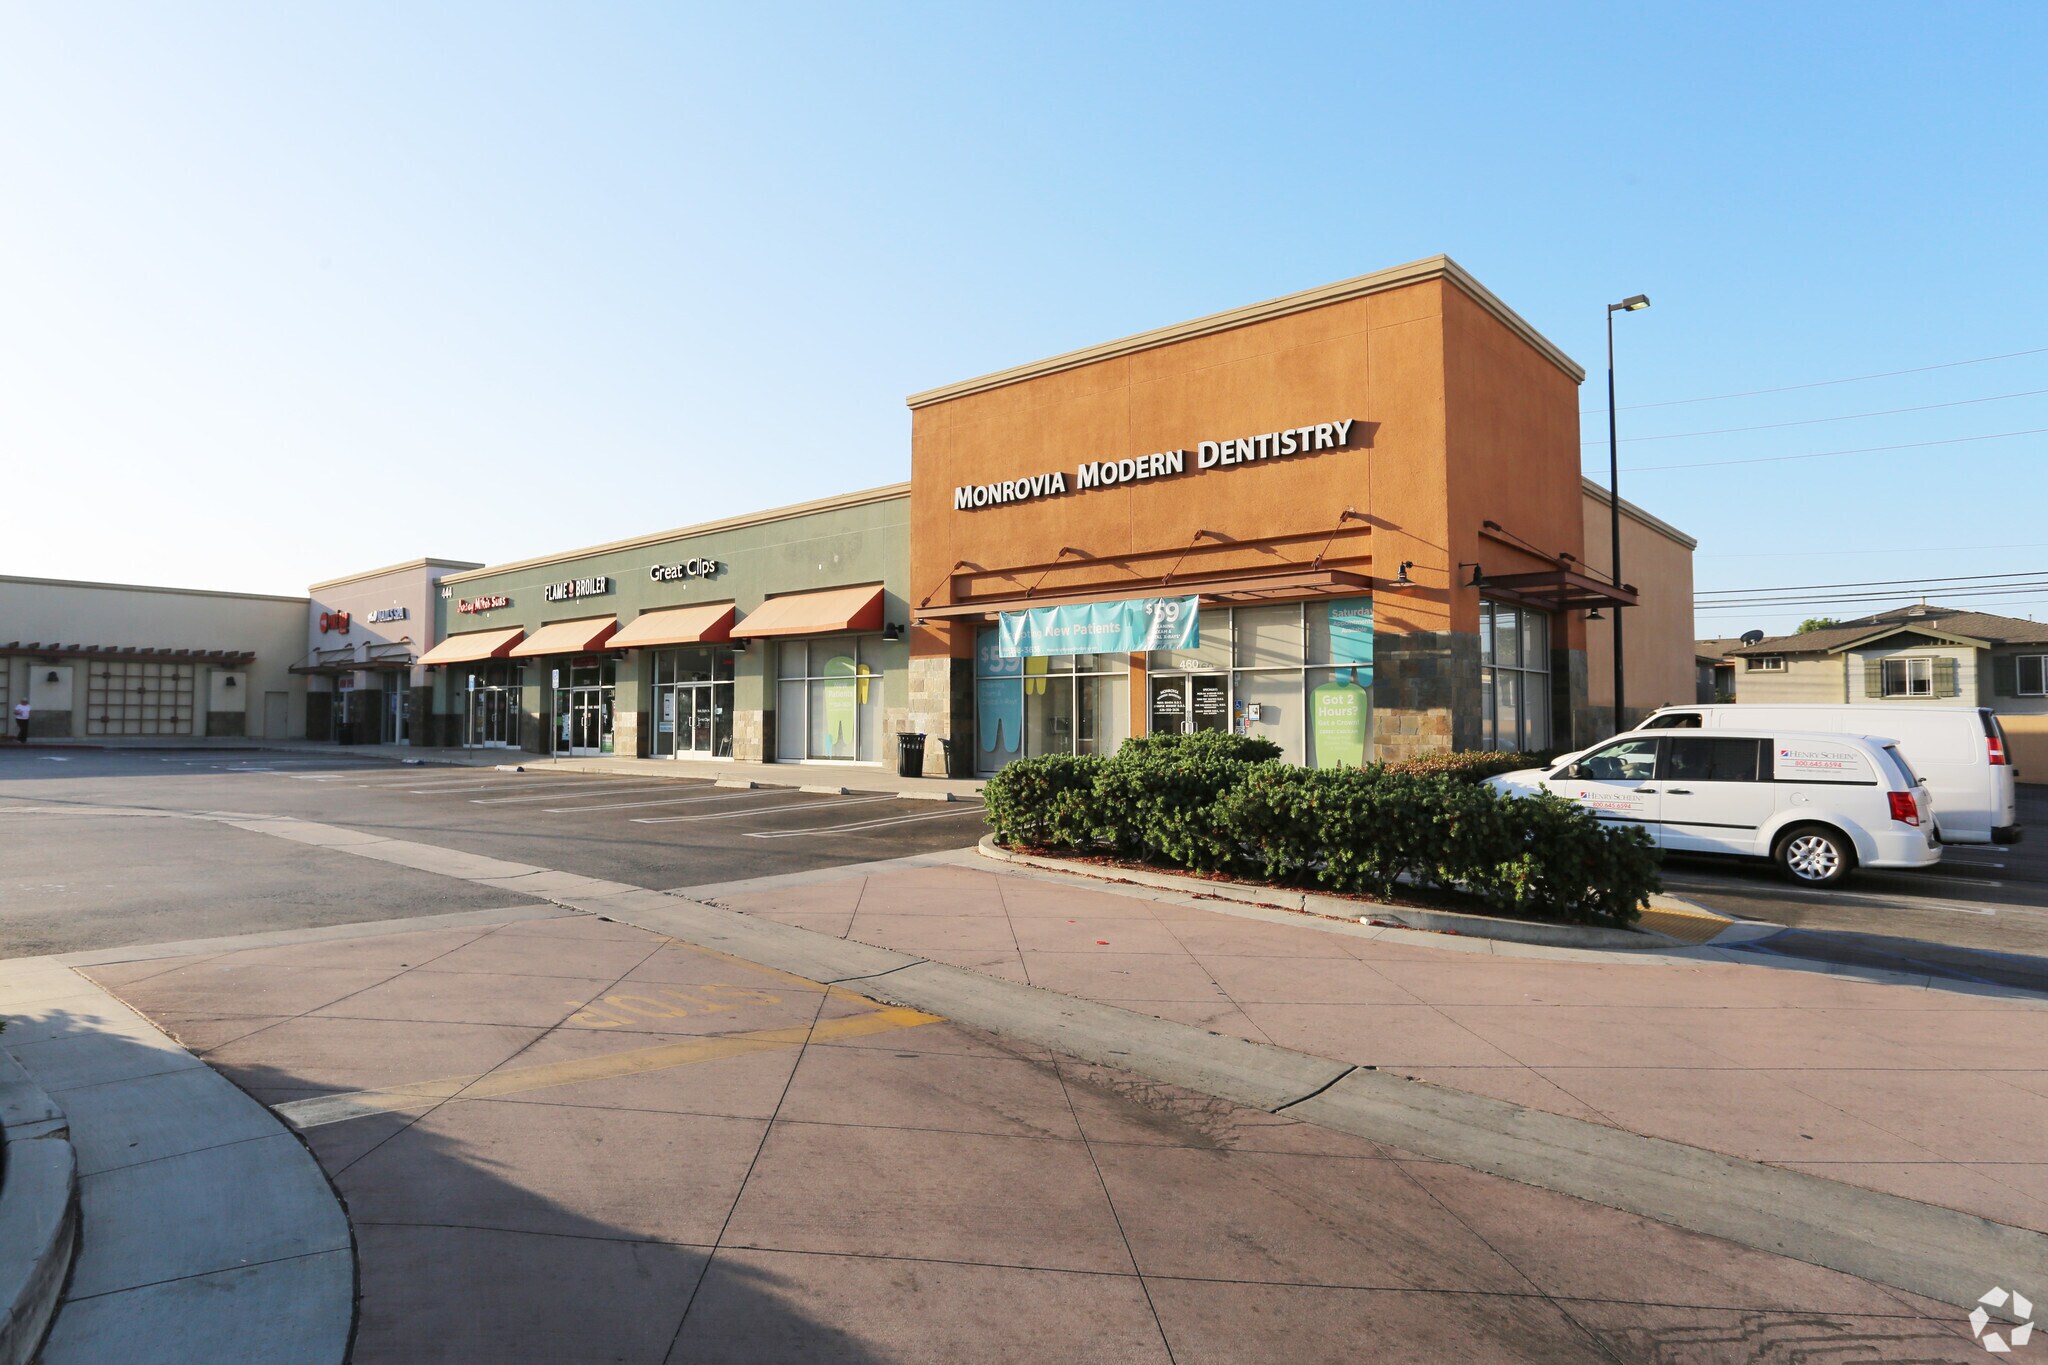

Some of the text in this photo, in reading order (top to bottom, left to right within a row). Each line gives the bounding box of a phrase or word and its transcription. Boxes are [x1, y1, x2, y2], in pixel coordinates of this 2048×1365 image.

[954, 418, 1353, 510] MONROVIA MODERN DENTISTRY
[650, 557, 715, 581] Great Clips
[441, 587, 453, 598] 444
[545, 577, 606, 601] FLAME BROILER
[1044, 626, 1070, 637] New
[1073, 622, 1121, 635] Patients
[1179, 659, 1198, 670] 460
[1323, 694, 1354, 705] Got 2
[1318, 706, 1358, 717] Hours?
[1790, 750, 1818, 759] HENRY
[1588, 791, 1612, 800] HENRY
[564, 983, 783, 1028] STOP
